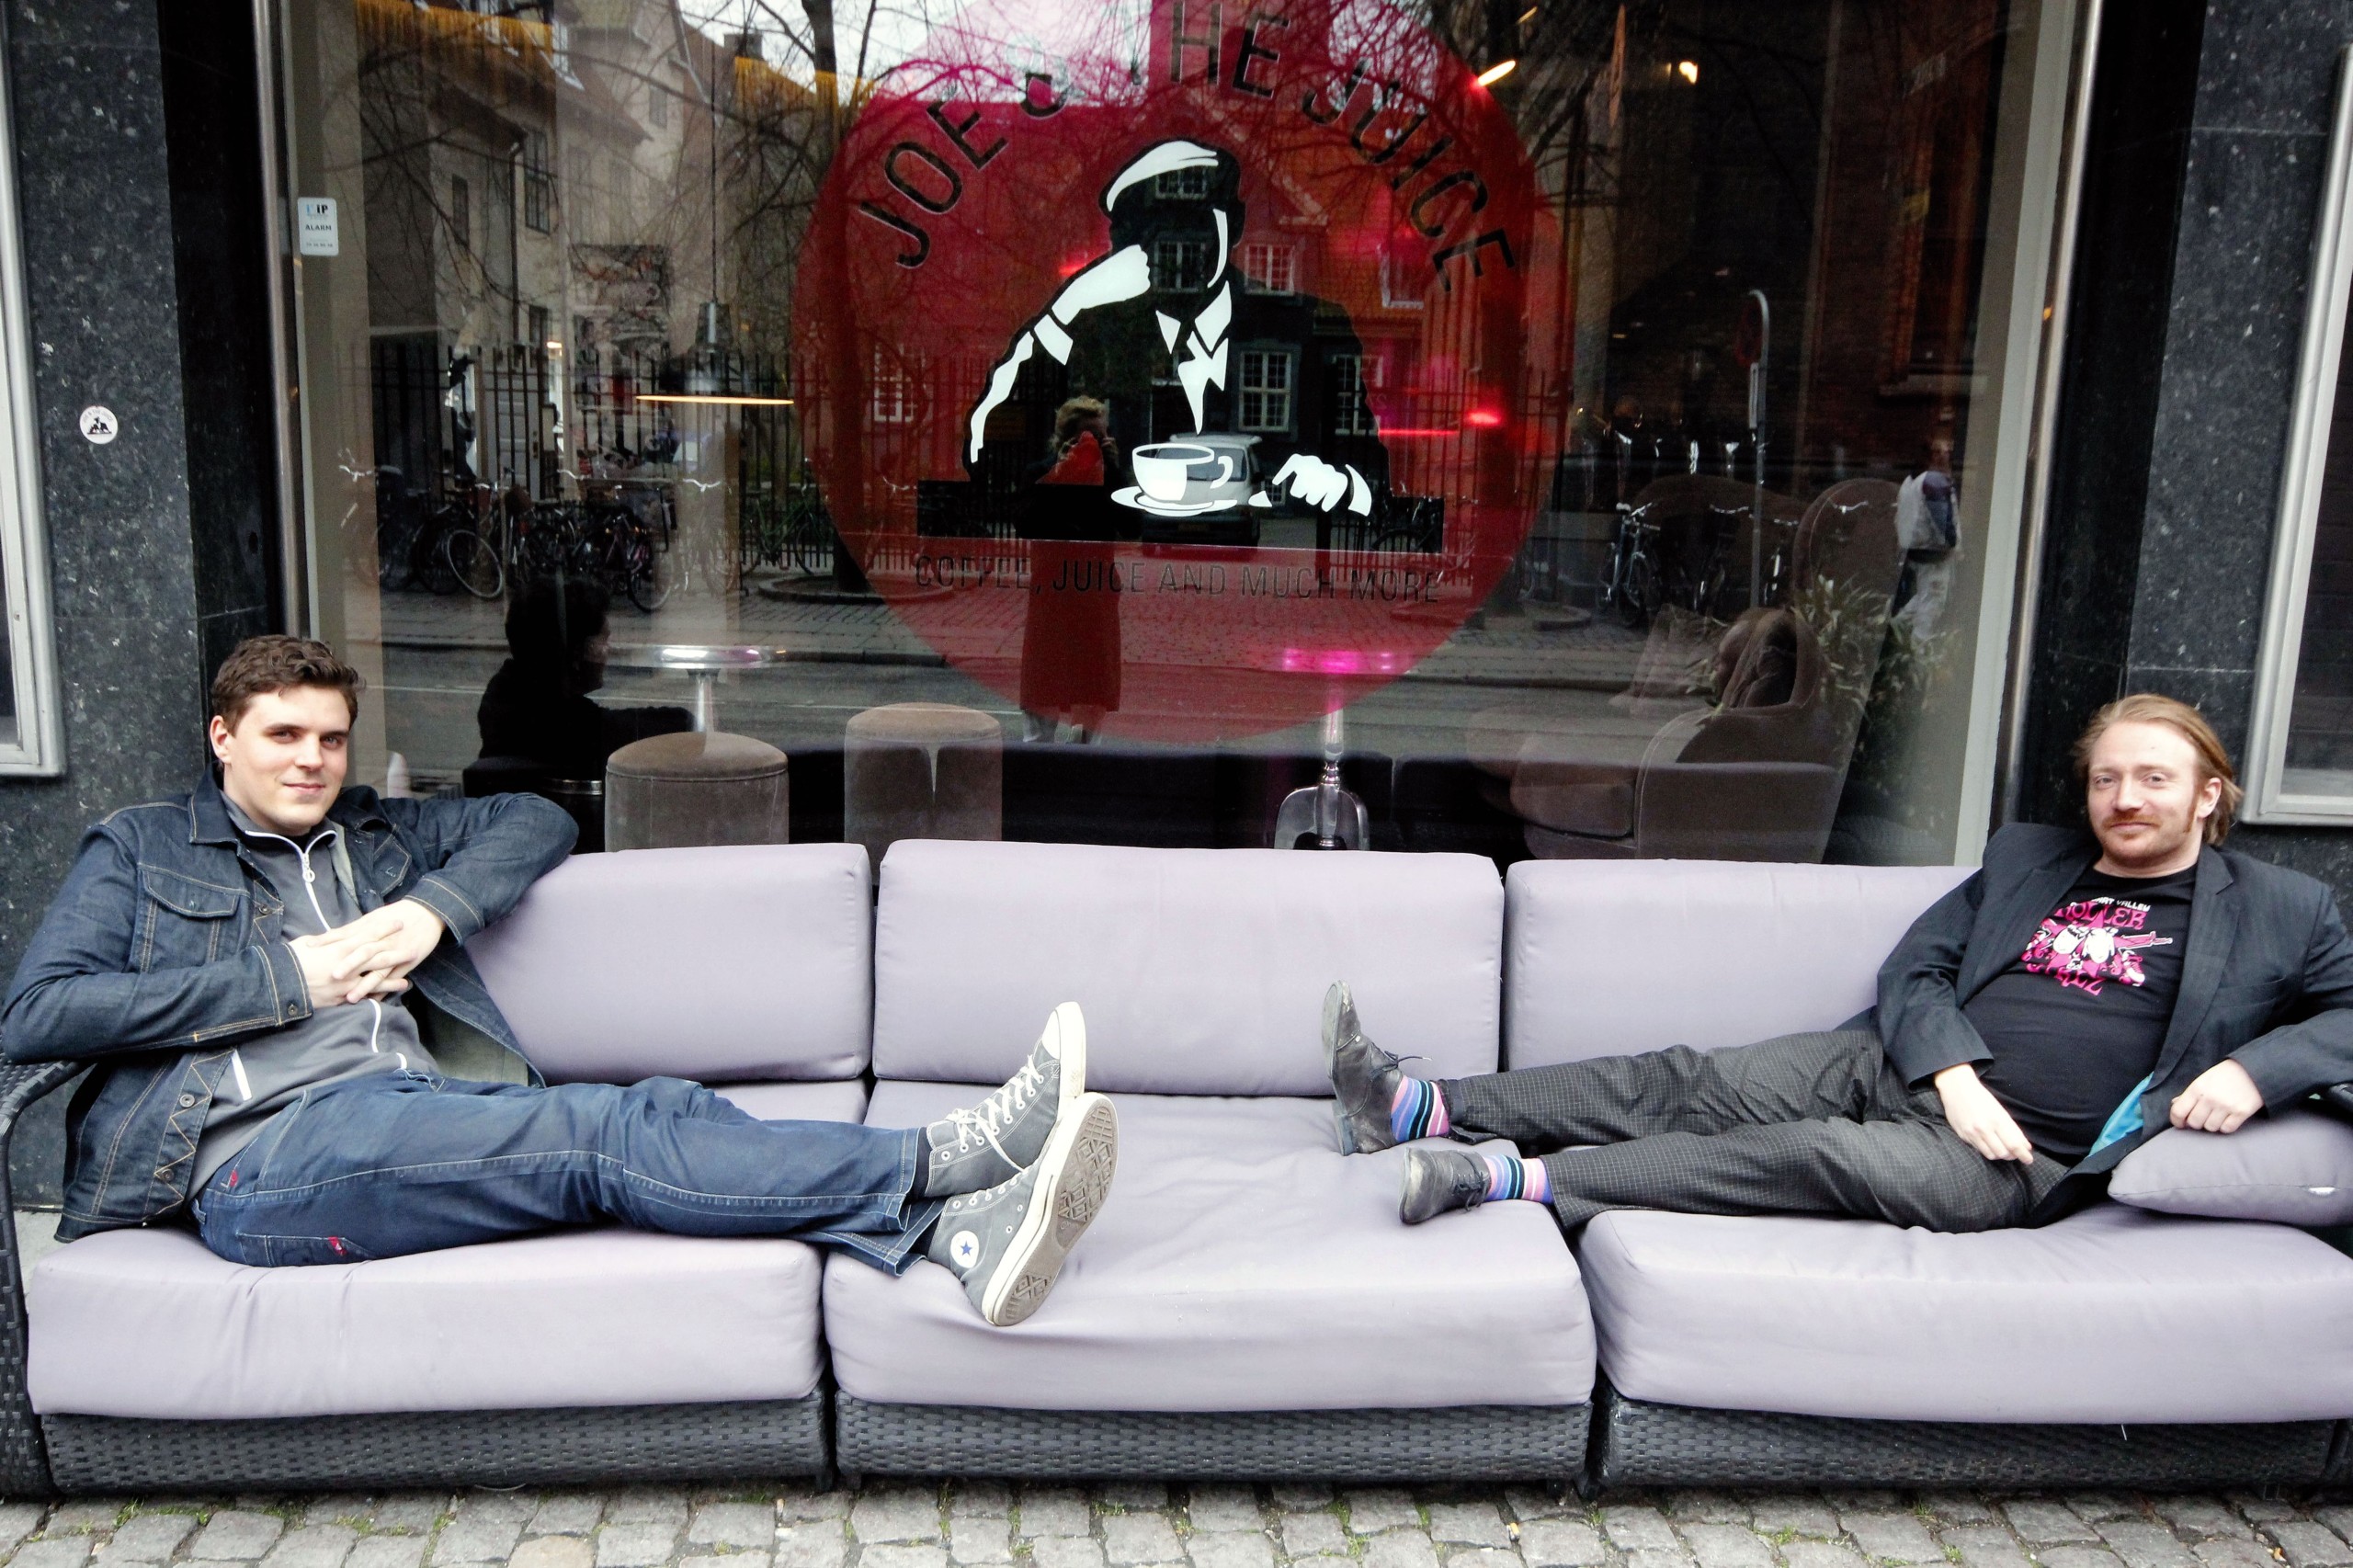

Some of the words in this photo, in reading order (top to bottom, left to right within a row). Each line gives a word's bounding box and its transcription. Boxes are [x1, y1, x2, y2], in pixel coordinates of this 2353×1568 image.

[858, 83, 1009, 268] JOE
[1302, 58, 1517, 292] JUICE
[1052, 559, 1145, 593] JUICE
[1158, 563, 1226, 595] AND
[1242, 566, 1335, 599] MUCH
[1349, 569, 1438, 603] MORE
